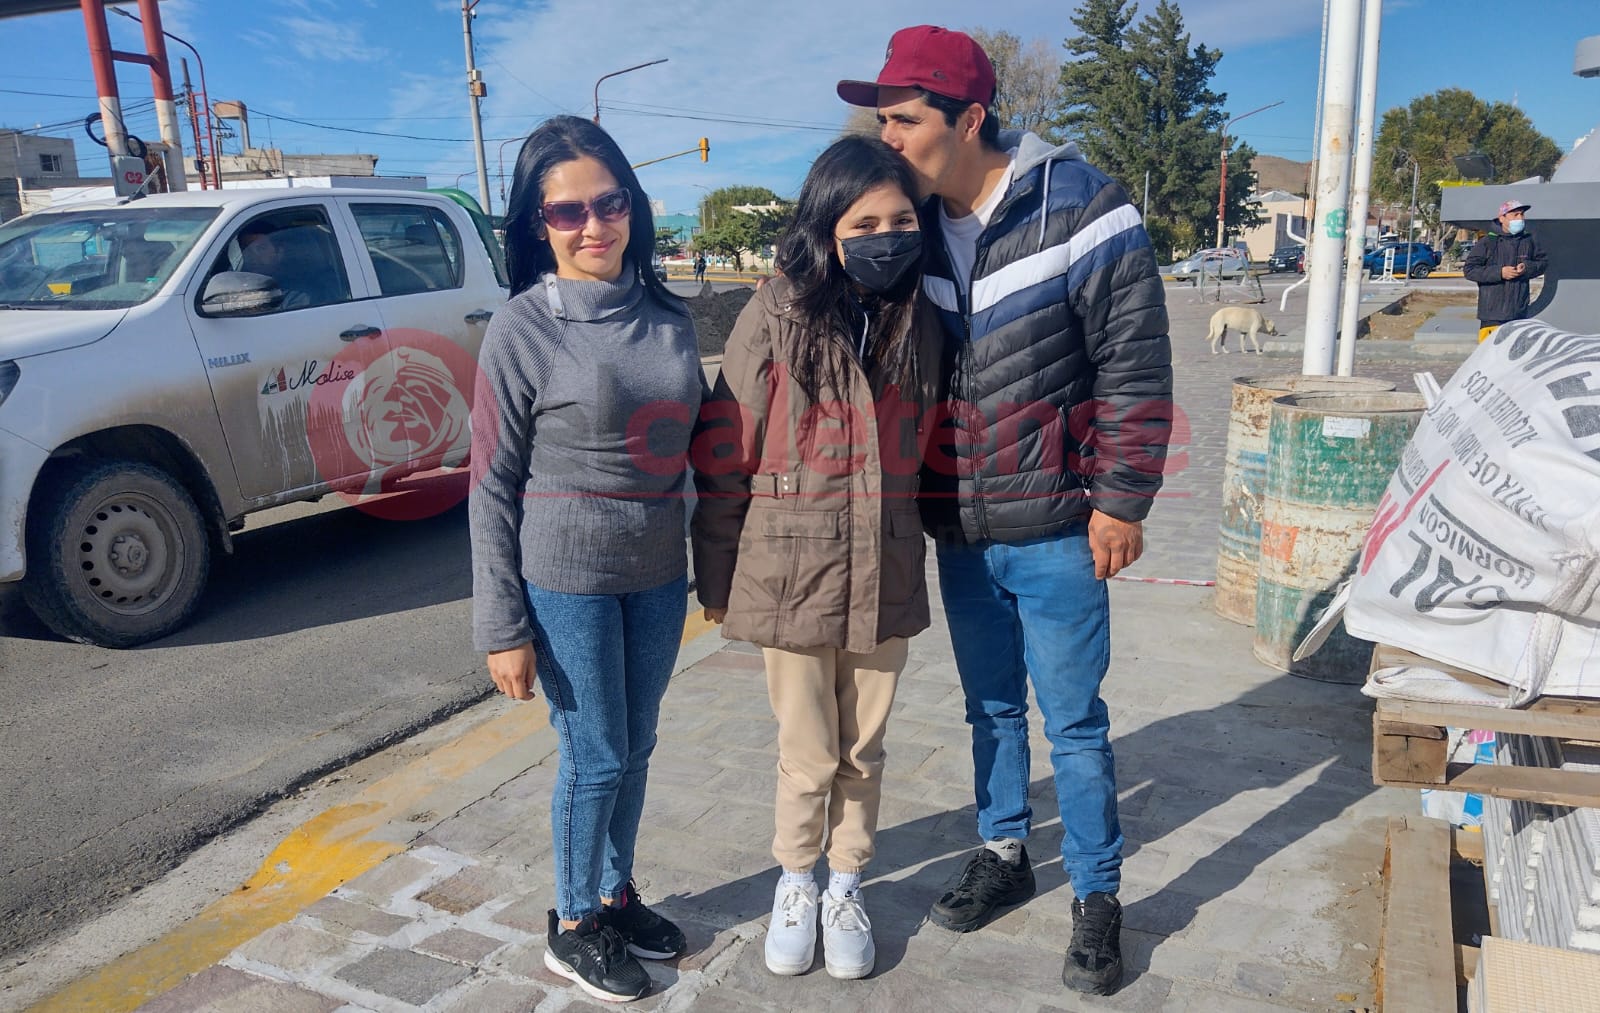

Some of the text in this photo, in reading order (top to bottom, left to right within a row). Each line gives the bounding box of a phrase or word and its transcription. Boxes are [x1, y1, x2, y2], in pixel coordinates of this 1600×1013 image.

[125, 171, 144, 184] C2
[208, 352, 251, 368] HILUX
[290, 360, 355, 390] Molise
